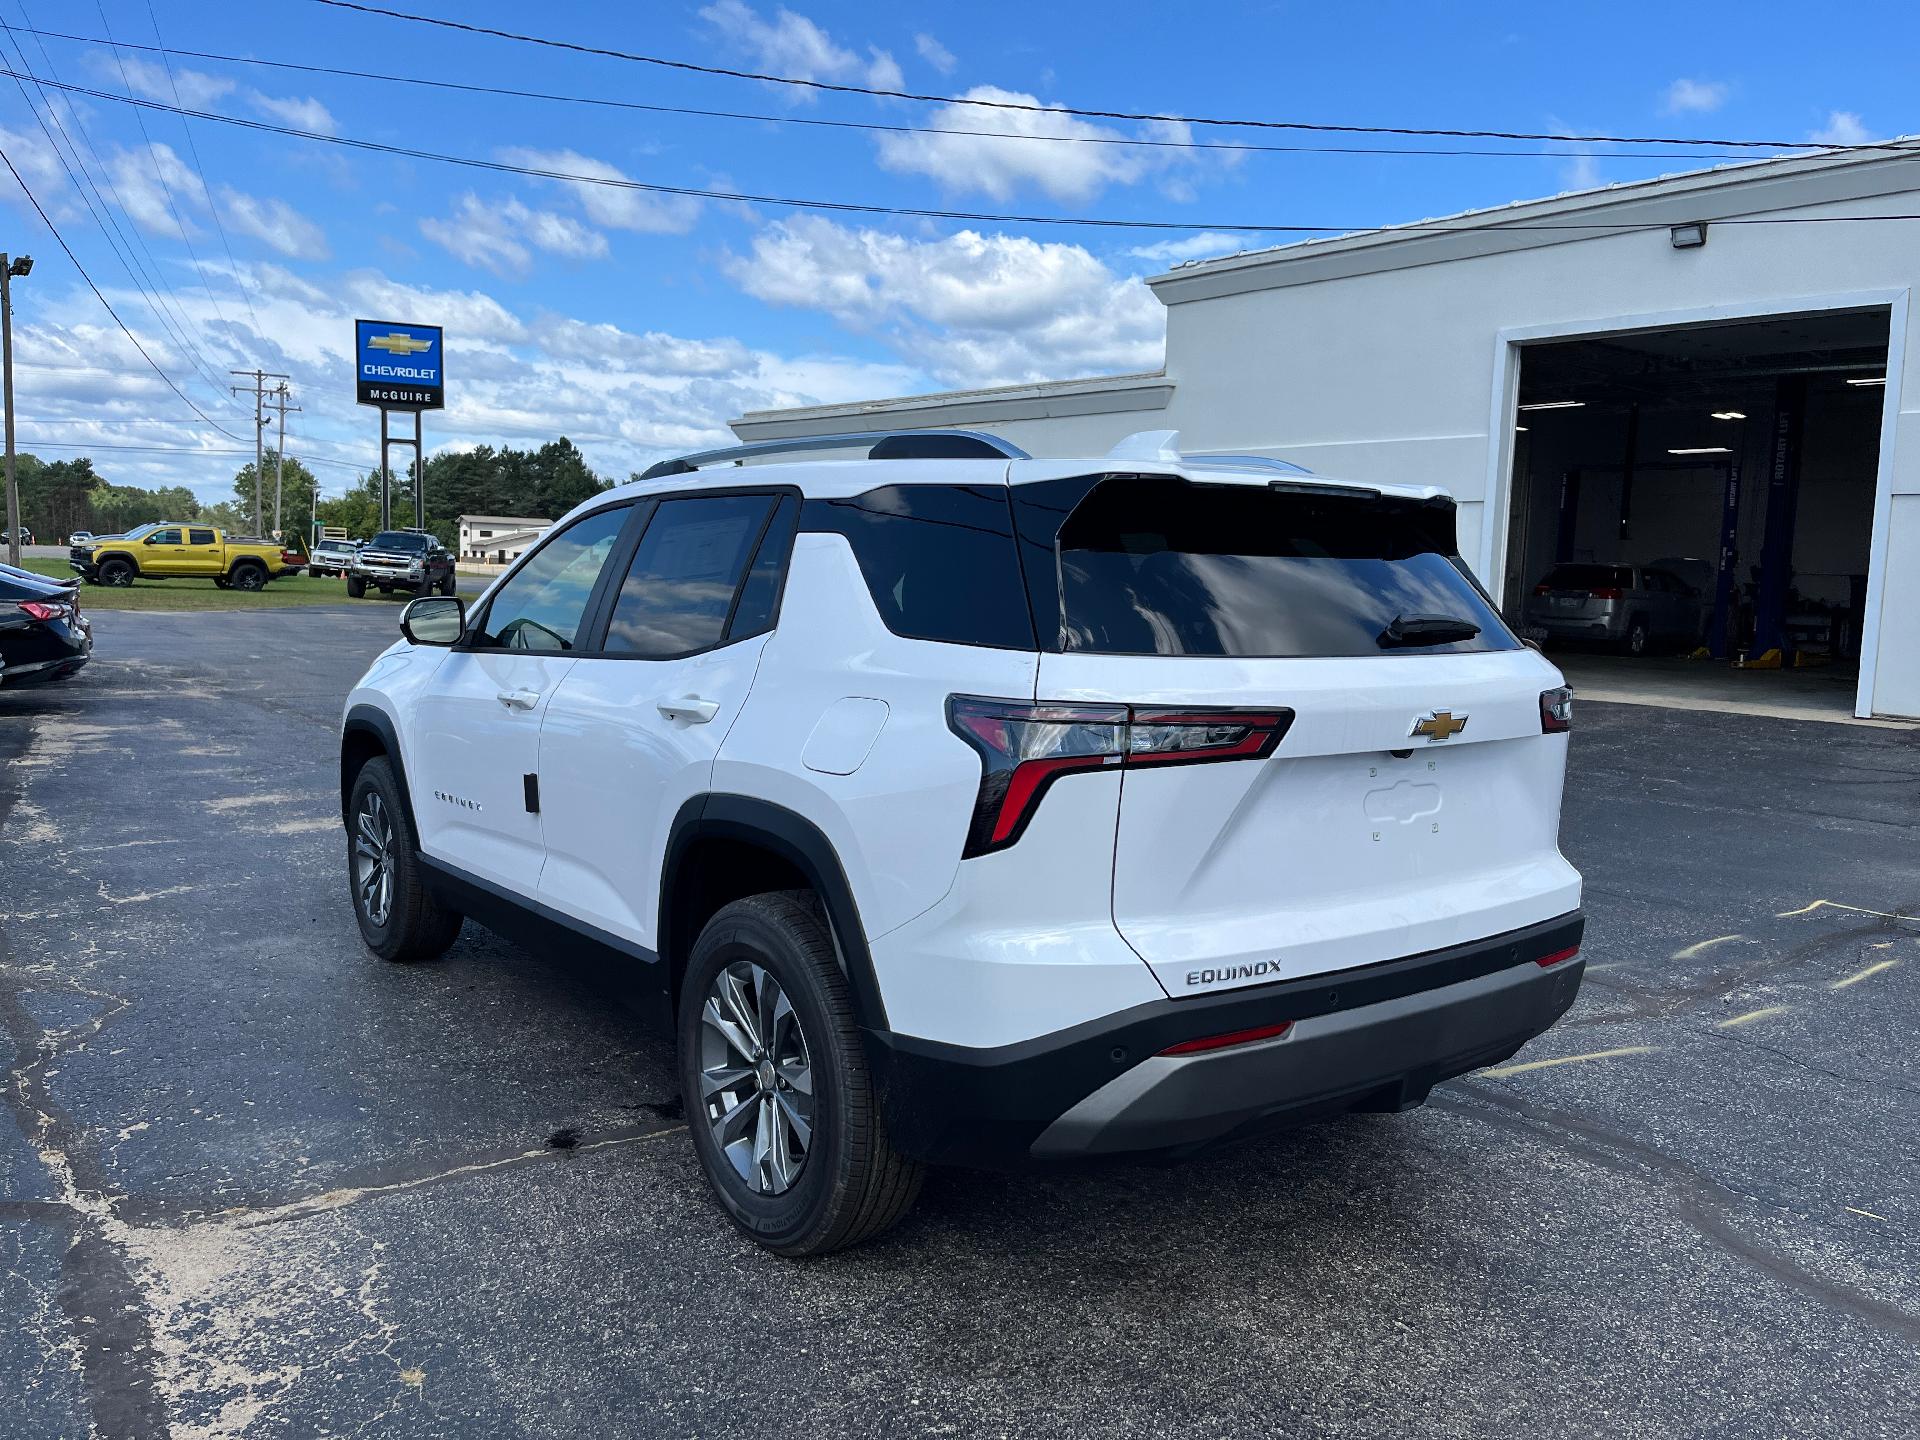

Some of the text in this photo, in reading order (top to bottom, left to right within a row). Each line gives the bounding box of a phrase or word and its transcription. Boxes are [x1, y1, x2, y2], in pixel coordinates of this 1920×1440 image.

[364, 365, 436, 379] CHEVROLET
[370, 389, 431, 402] McGUIRE
[1186, 960, 1281, 985] EQUINOX
